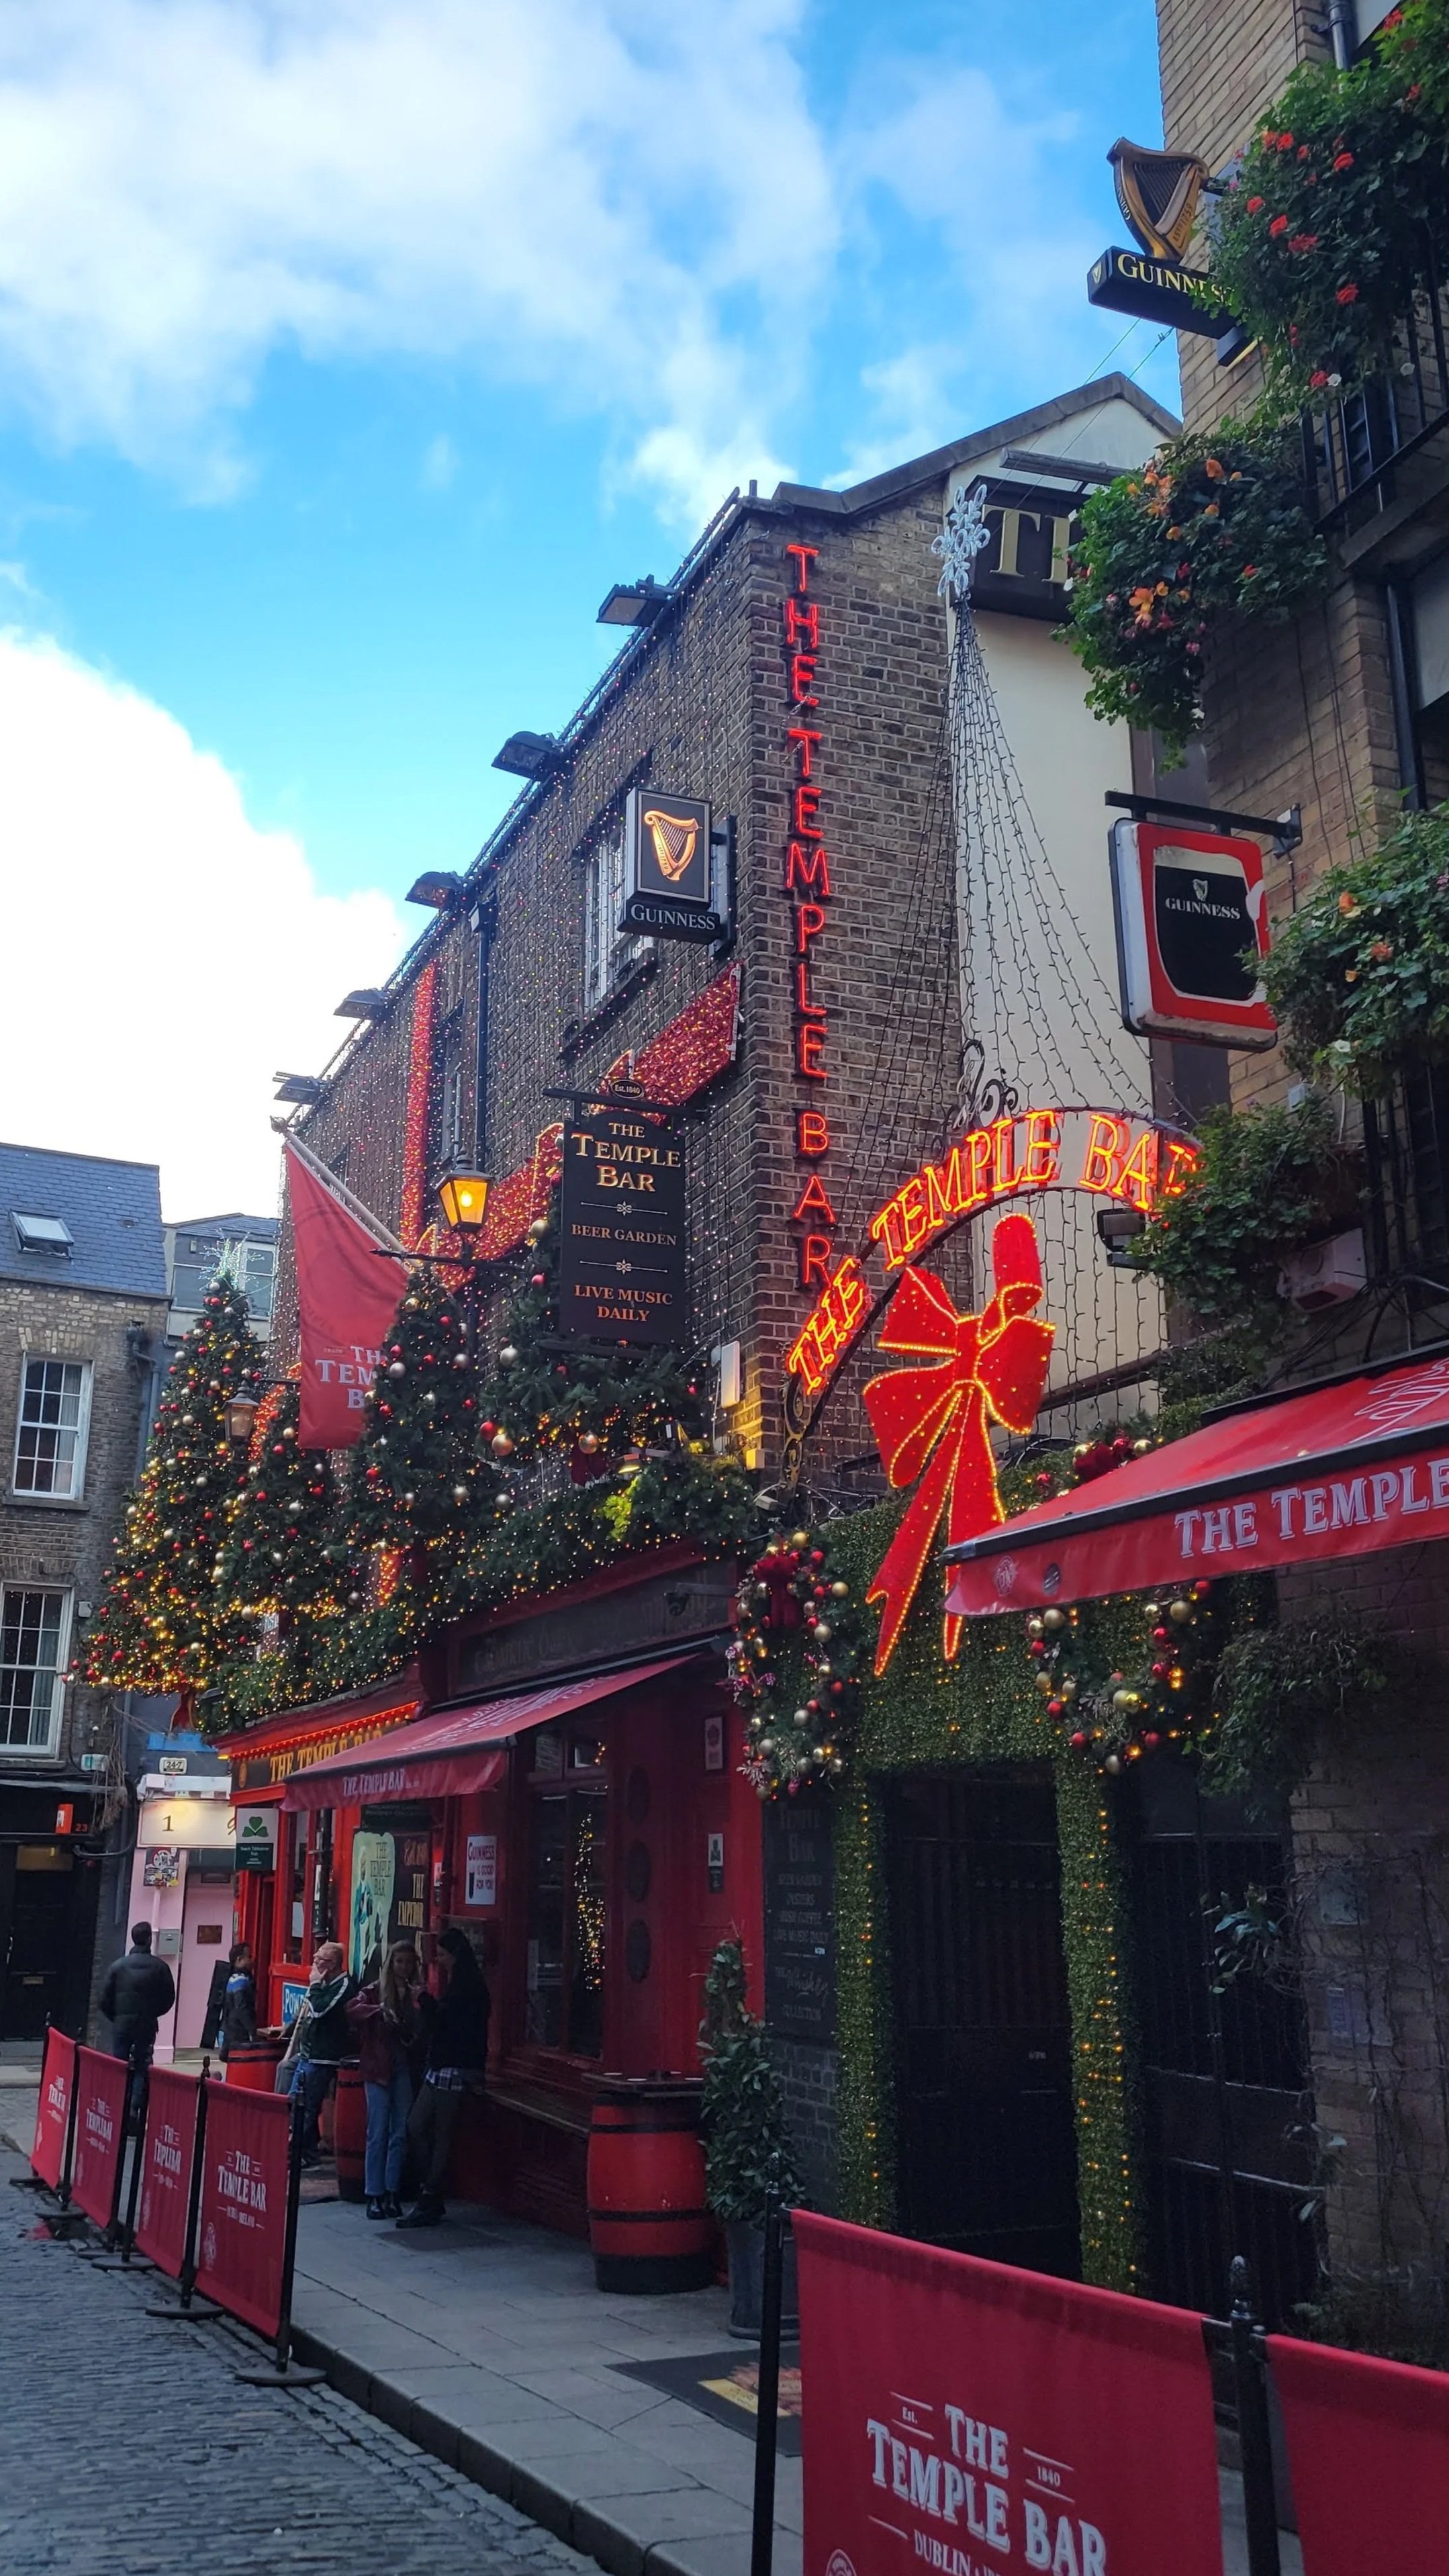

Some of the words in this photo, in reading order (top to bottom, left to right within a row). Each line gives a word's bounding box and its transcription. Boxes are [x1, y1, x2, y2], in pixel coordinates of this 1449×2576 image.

[786, 543, 819, 707] THE
[786, 729, 831, 1079] TEMPLE
[1165, 897, 1241, 920] GUINNESS
[630, 904, 715, 930] GUINNESS
[608, 1122, 645, 1138] THE
[571, 1133, 681, 1168] TEMPLE
[596, 1164, 656, 1192] BAR
[793, 1111, 835, 1289] BAR
[571, 1224, 610, 1239] BEER
[614, 1229, 677, 1245] GARDEN
[788, 1256, 866, 1395] THE
[871, 1110, 1060, 1270] TEMPLE
[574, 1285, 614, 1300] LIVE
[618, 1289, 673, 1305] MUSIC
[597, 1306, 650, 1322] DAILY
[350, 1345, 381, 1365] TH
[1174, 1502, 1258, 1558] THE
[1271, 1457, 1449, 1540] TEMPLE
[376, 1842, 387, 1859] THE
[468, 1842, 495, 1861] GUINNESS
[371, 1860, 391, 1878] TEMPLE
[375, 1878, 386, 1896] BAR
[236, 2150, 250, 2175] THE
[218, 2164, 249, 2204] TEMPLE
[250, 2180, 267, 2212] BAR
[902, 2406, 918, 2424] Est.
[945, 2403, 1009, 2479] THE
[1037, 2465, 1061, 2487] 1840
[867, 2418, 1011, 2553] TEMPLE
[1023, 2498, 1107, 2576] BAR
[914, 2528, 971, 2576] DUBLIN
